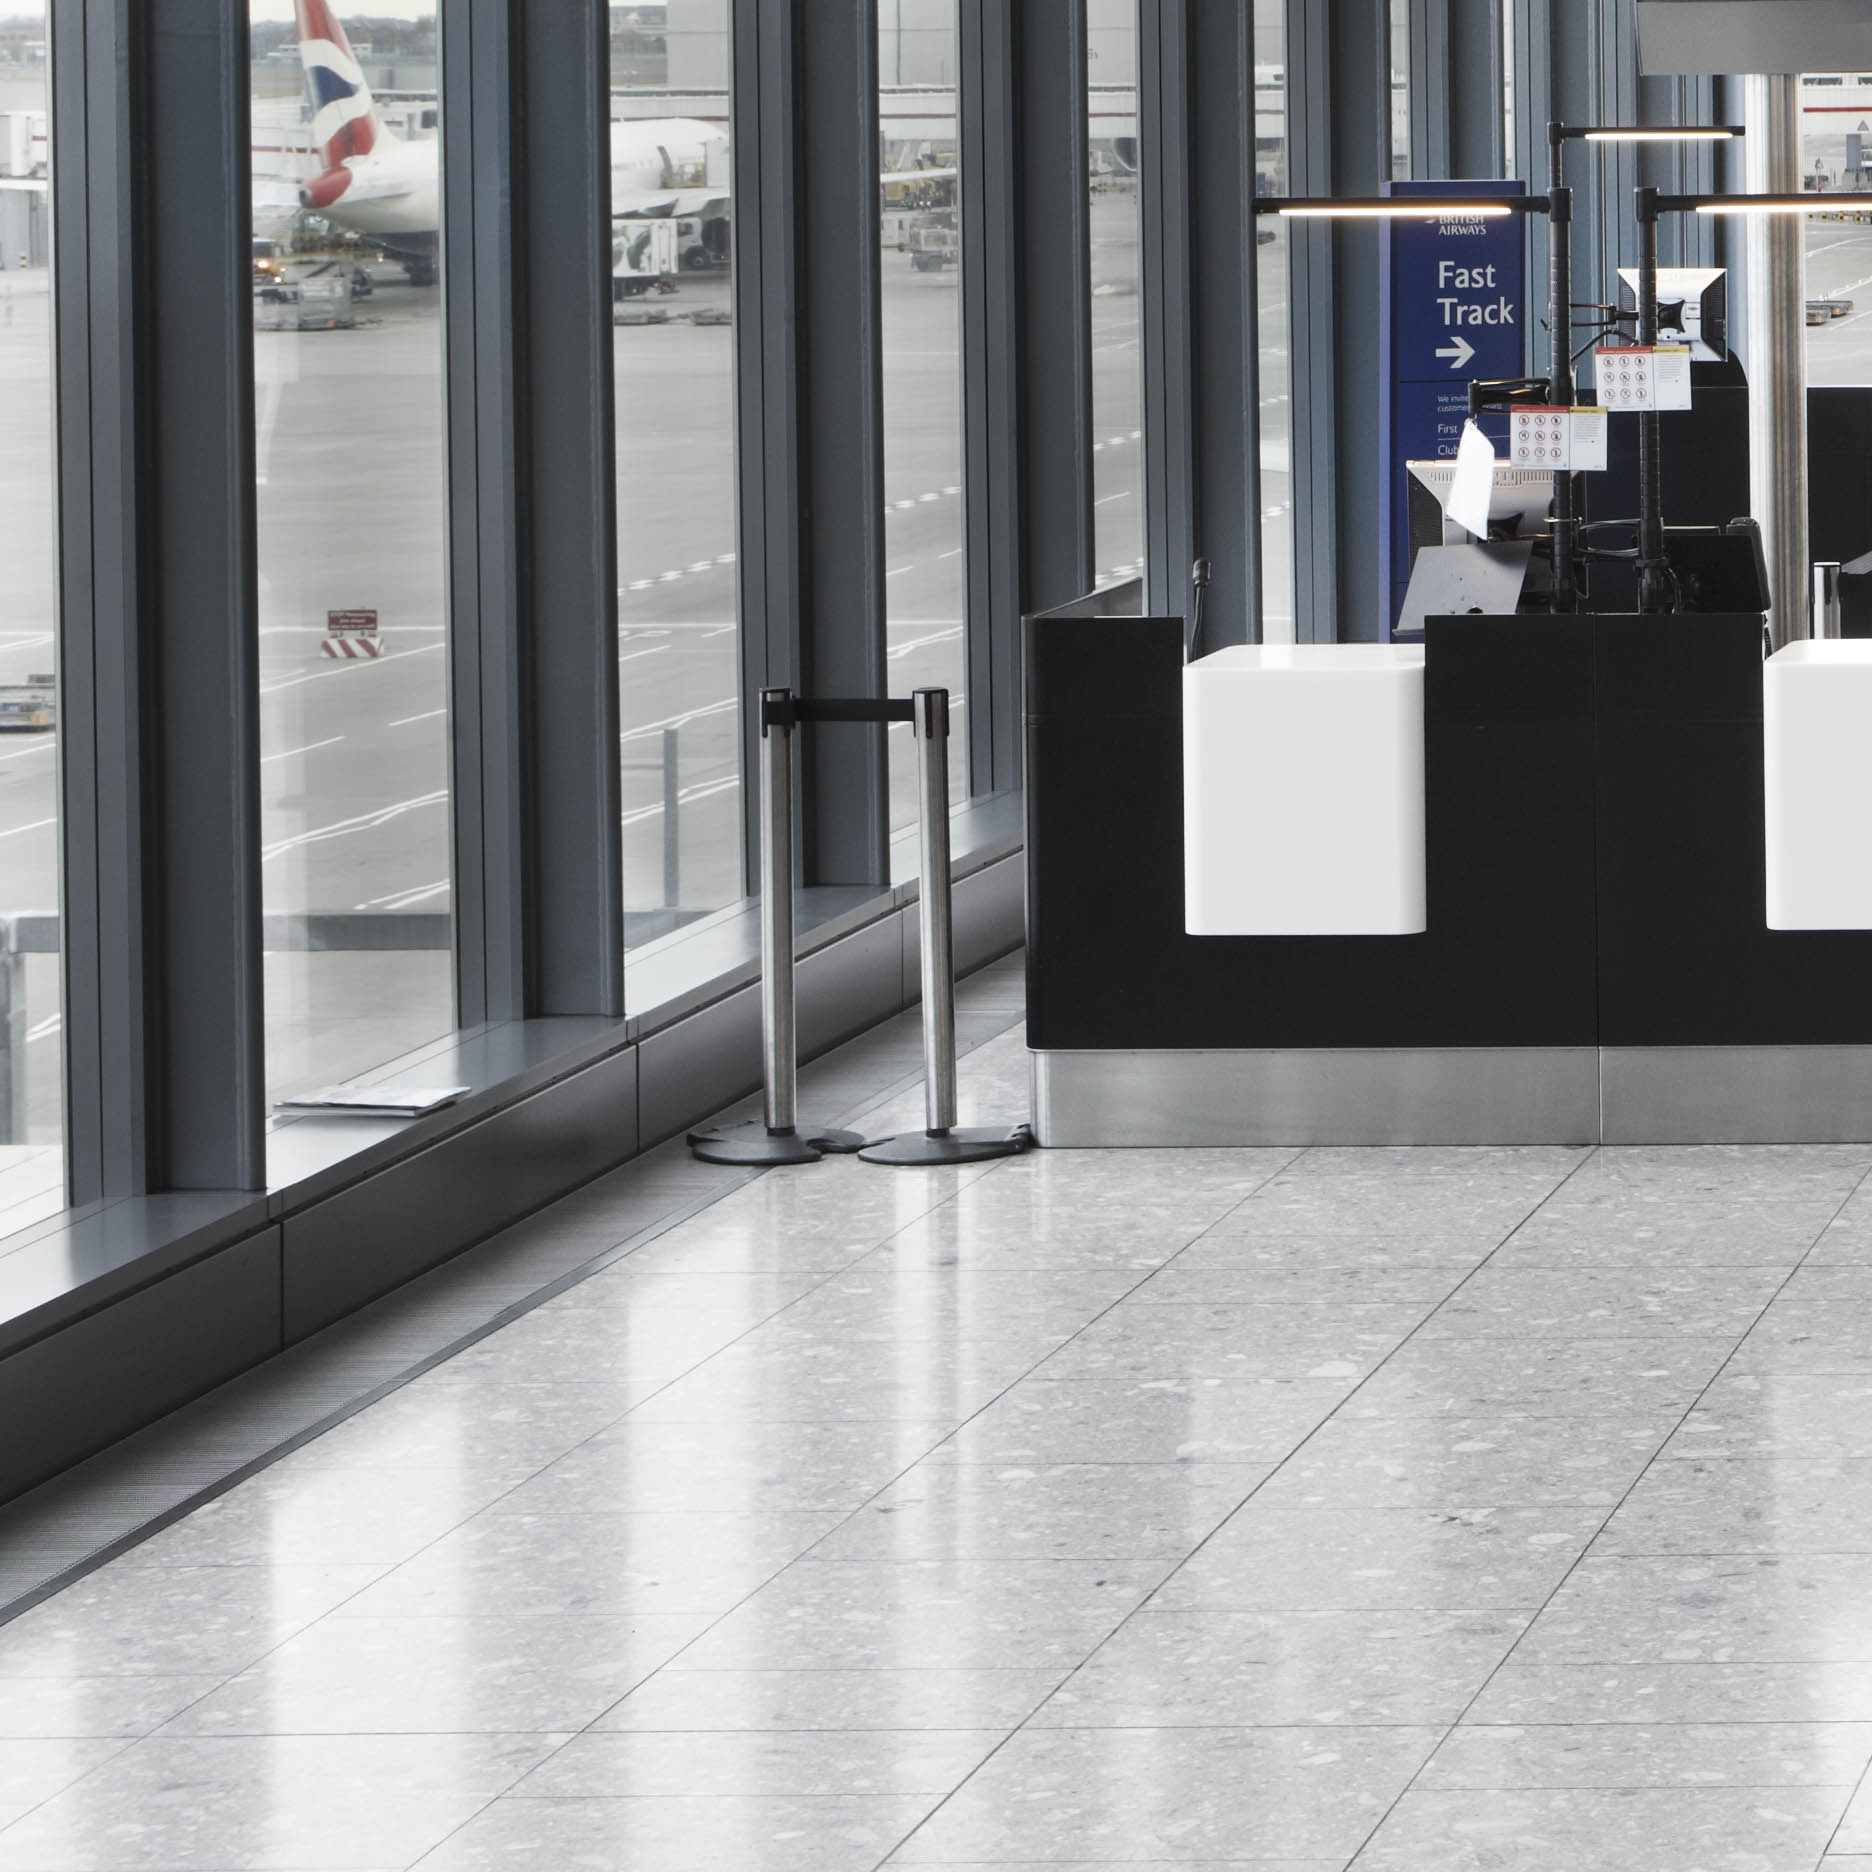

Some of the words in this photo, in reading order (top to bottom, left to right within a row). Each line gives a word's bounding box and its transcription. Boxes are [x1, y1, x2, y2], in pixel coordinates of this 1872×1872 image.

[1439, 215, 1484, 224] BRITISH
[1439, 225, 1487, 235] AIRWAYS
[1438, 260, 1496, 289] Fast
[1436, 296, 1514, 326] Track
[1437, 423, 1458, 434] First
